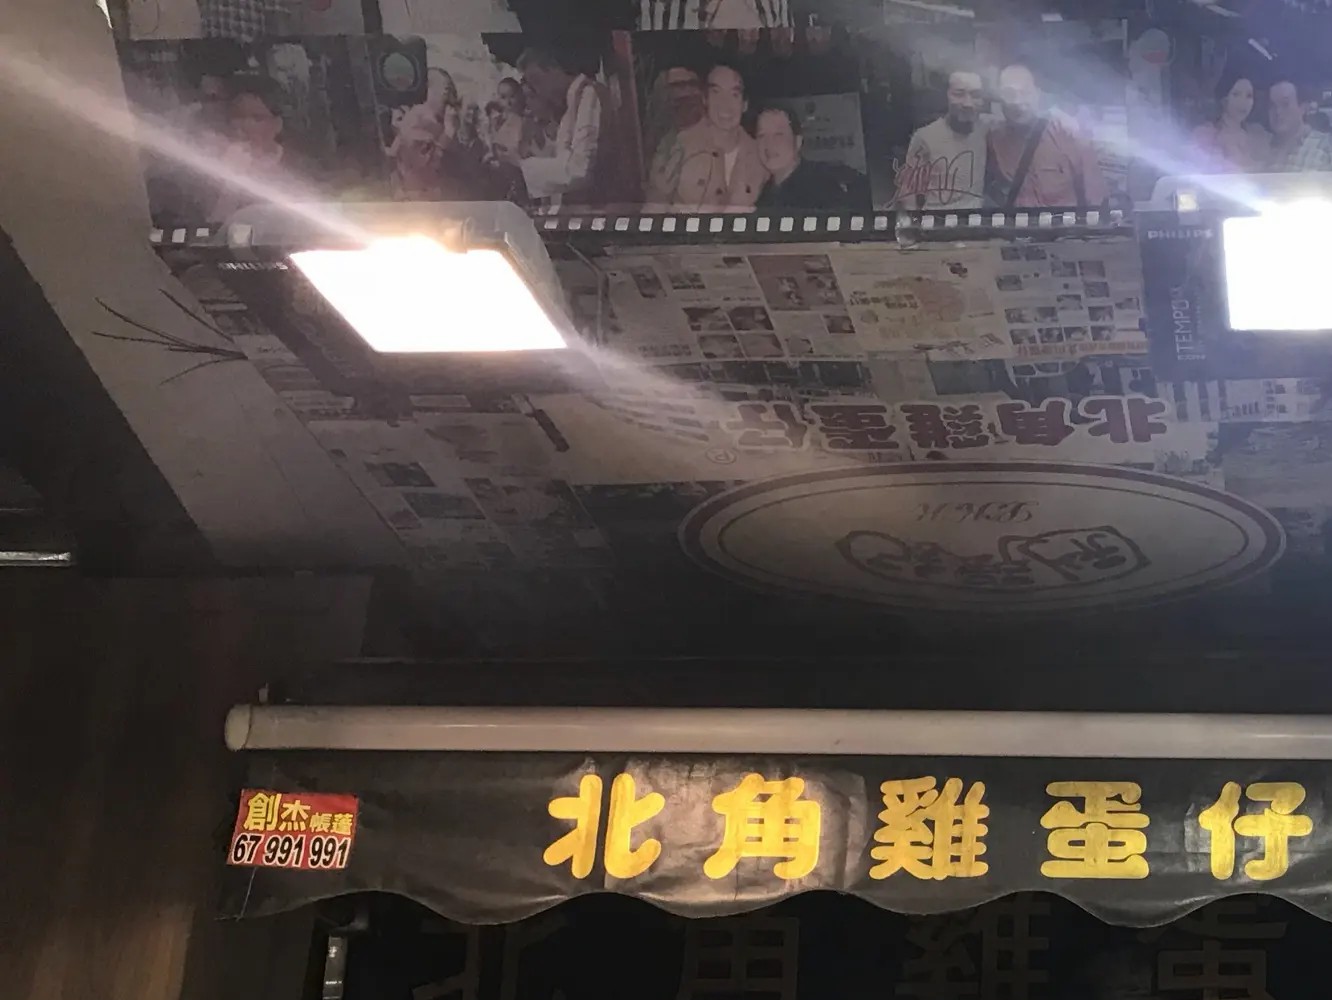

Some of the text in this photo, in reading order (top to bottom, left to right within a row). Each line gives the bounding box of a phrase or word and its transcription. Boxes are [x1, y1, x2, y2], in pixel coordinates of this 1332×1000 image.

[1148, 230, 1214, 239] PHILIPS
[724, 399, 1168, 450] 北角雞蛋仔
[544, 771, 1315, 882] 北角雞蛋仔
[232, 833, 351, 868] 67 991 991
